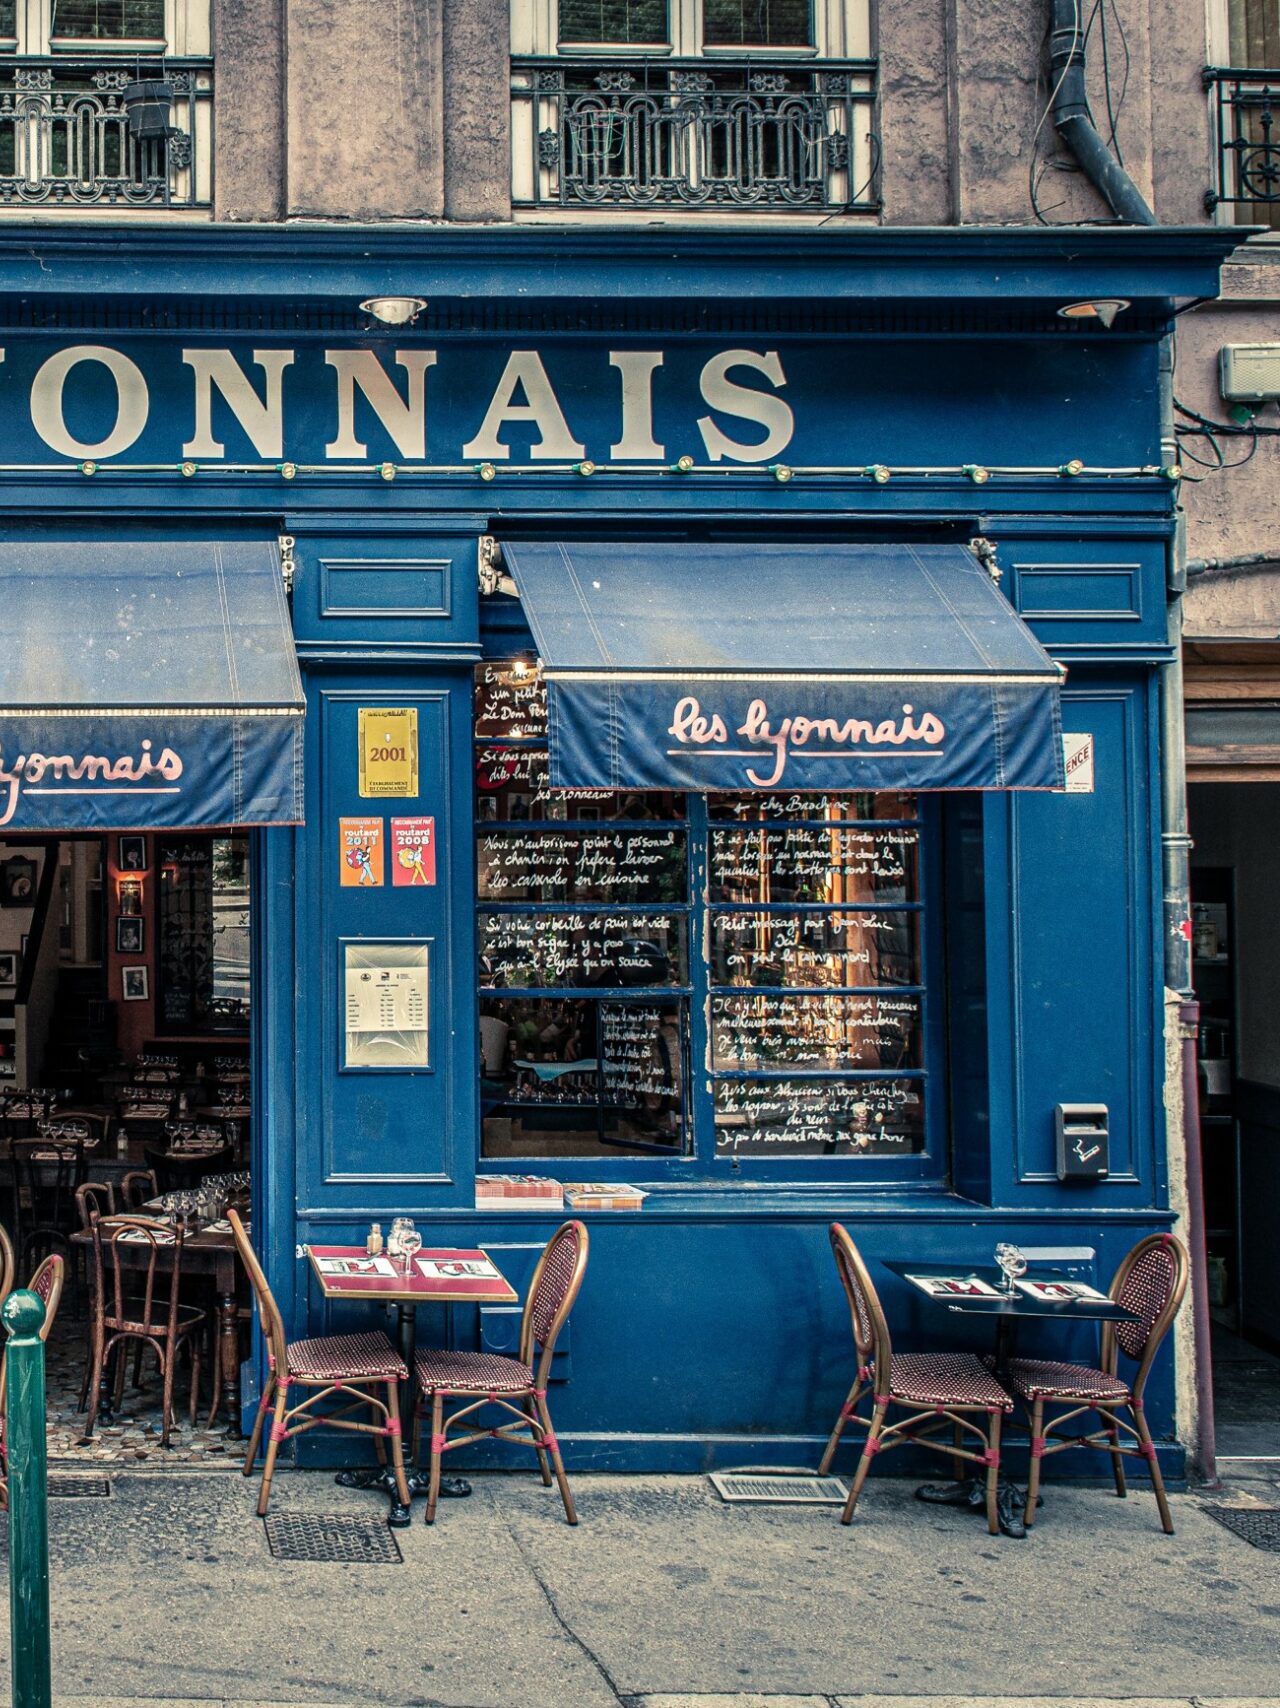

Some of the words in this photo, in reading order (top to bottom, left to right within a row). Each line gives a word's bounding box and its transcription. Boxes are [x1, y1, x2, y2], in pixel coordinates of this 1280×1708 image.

[500, 705, 526, 720] Dom
[668, 696, 727, 743] les
[737, 699, 945, 786] lyonnais
[370, 747, 407, 762] 2001
[480, 750, 496, 763] Si
[347, 836, 377, 845] 2011
[397, 836, 430, 845] 2008
[483, 833, 509, 851] Nous
[595, 871, 650, 886] cuisine
[485, 917, 503, 932] Si
[648, 915, 671, 929] vide
[862, 914, 894, 930] Luc
[581, 939, 591, 956] y
[727, 954, 746, 965] on
